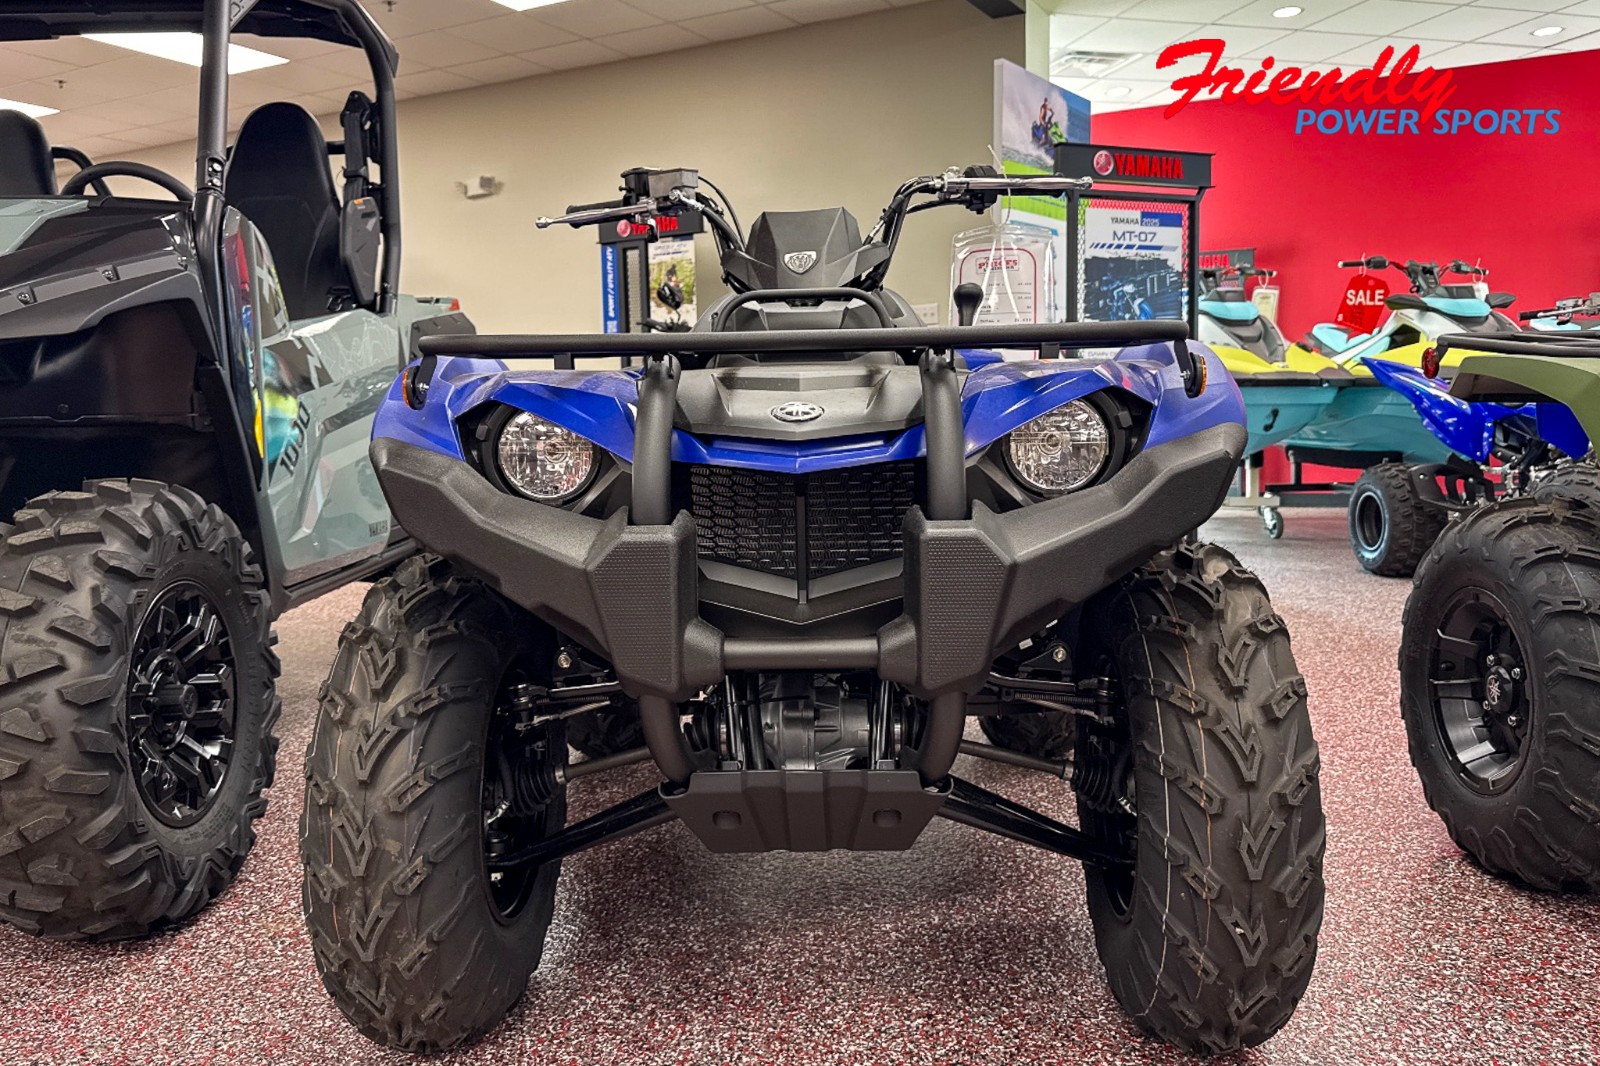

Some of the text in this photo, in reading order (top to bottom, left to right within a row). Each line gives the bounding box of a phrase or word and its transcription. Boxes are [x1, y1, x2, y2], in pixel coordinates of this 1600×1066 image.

[1114, 153, 1184, 179] YAMAHA
[1110, 216, 1140, 226] YAMAHA
[1112, 229, 1157, 243] MT-07
[1346, 289, 1385, 306] SALE
[280, 401, 311, 478] 1000
